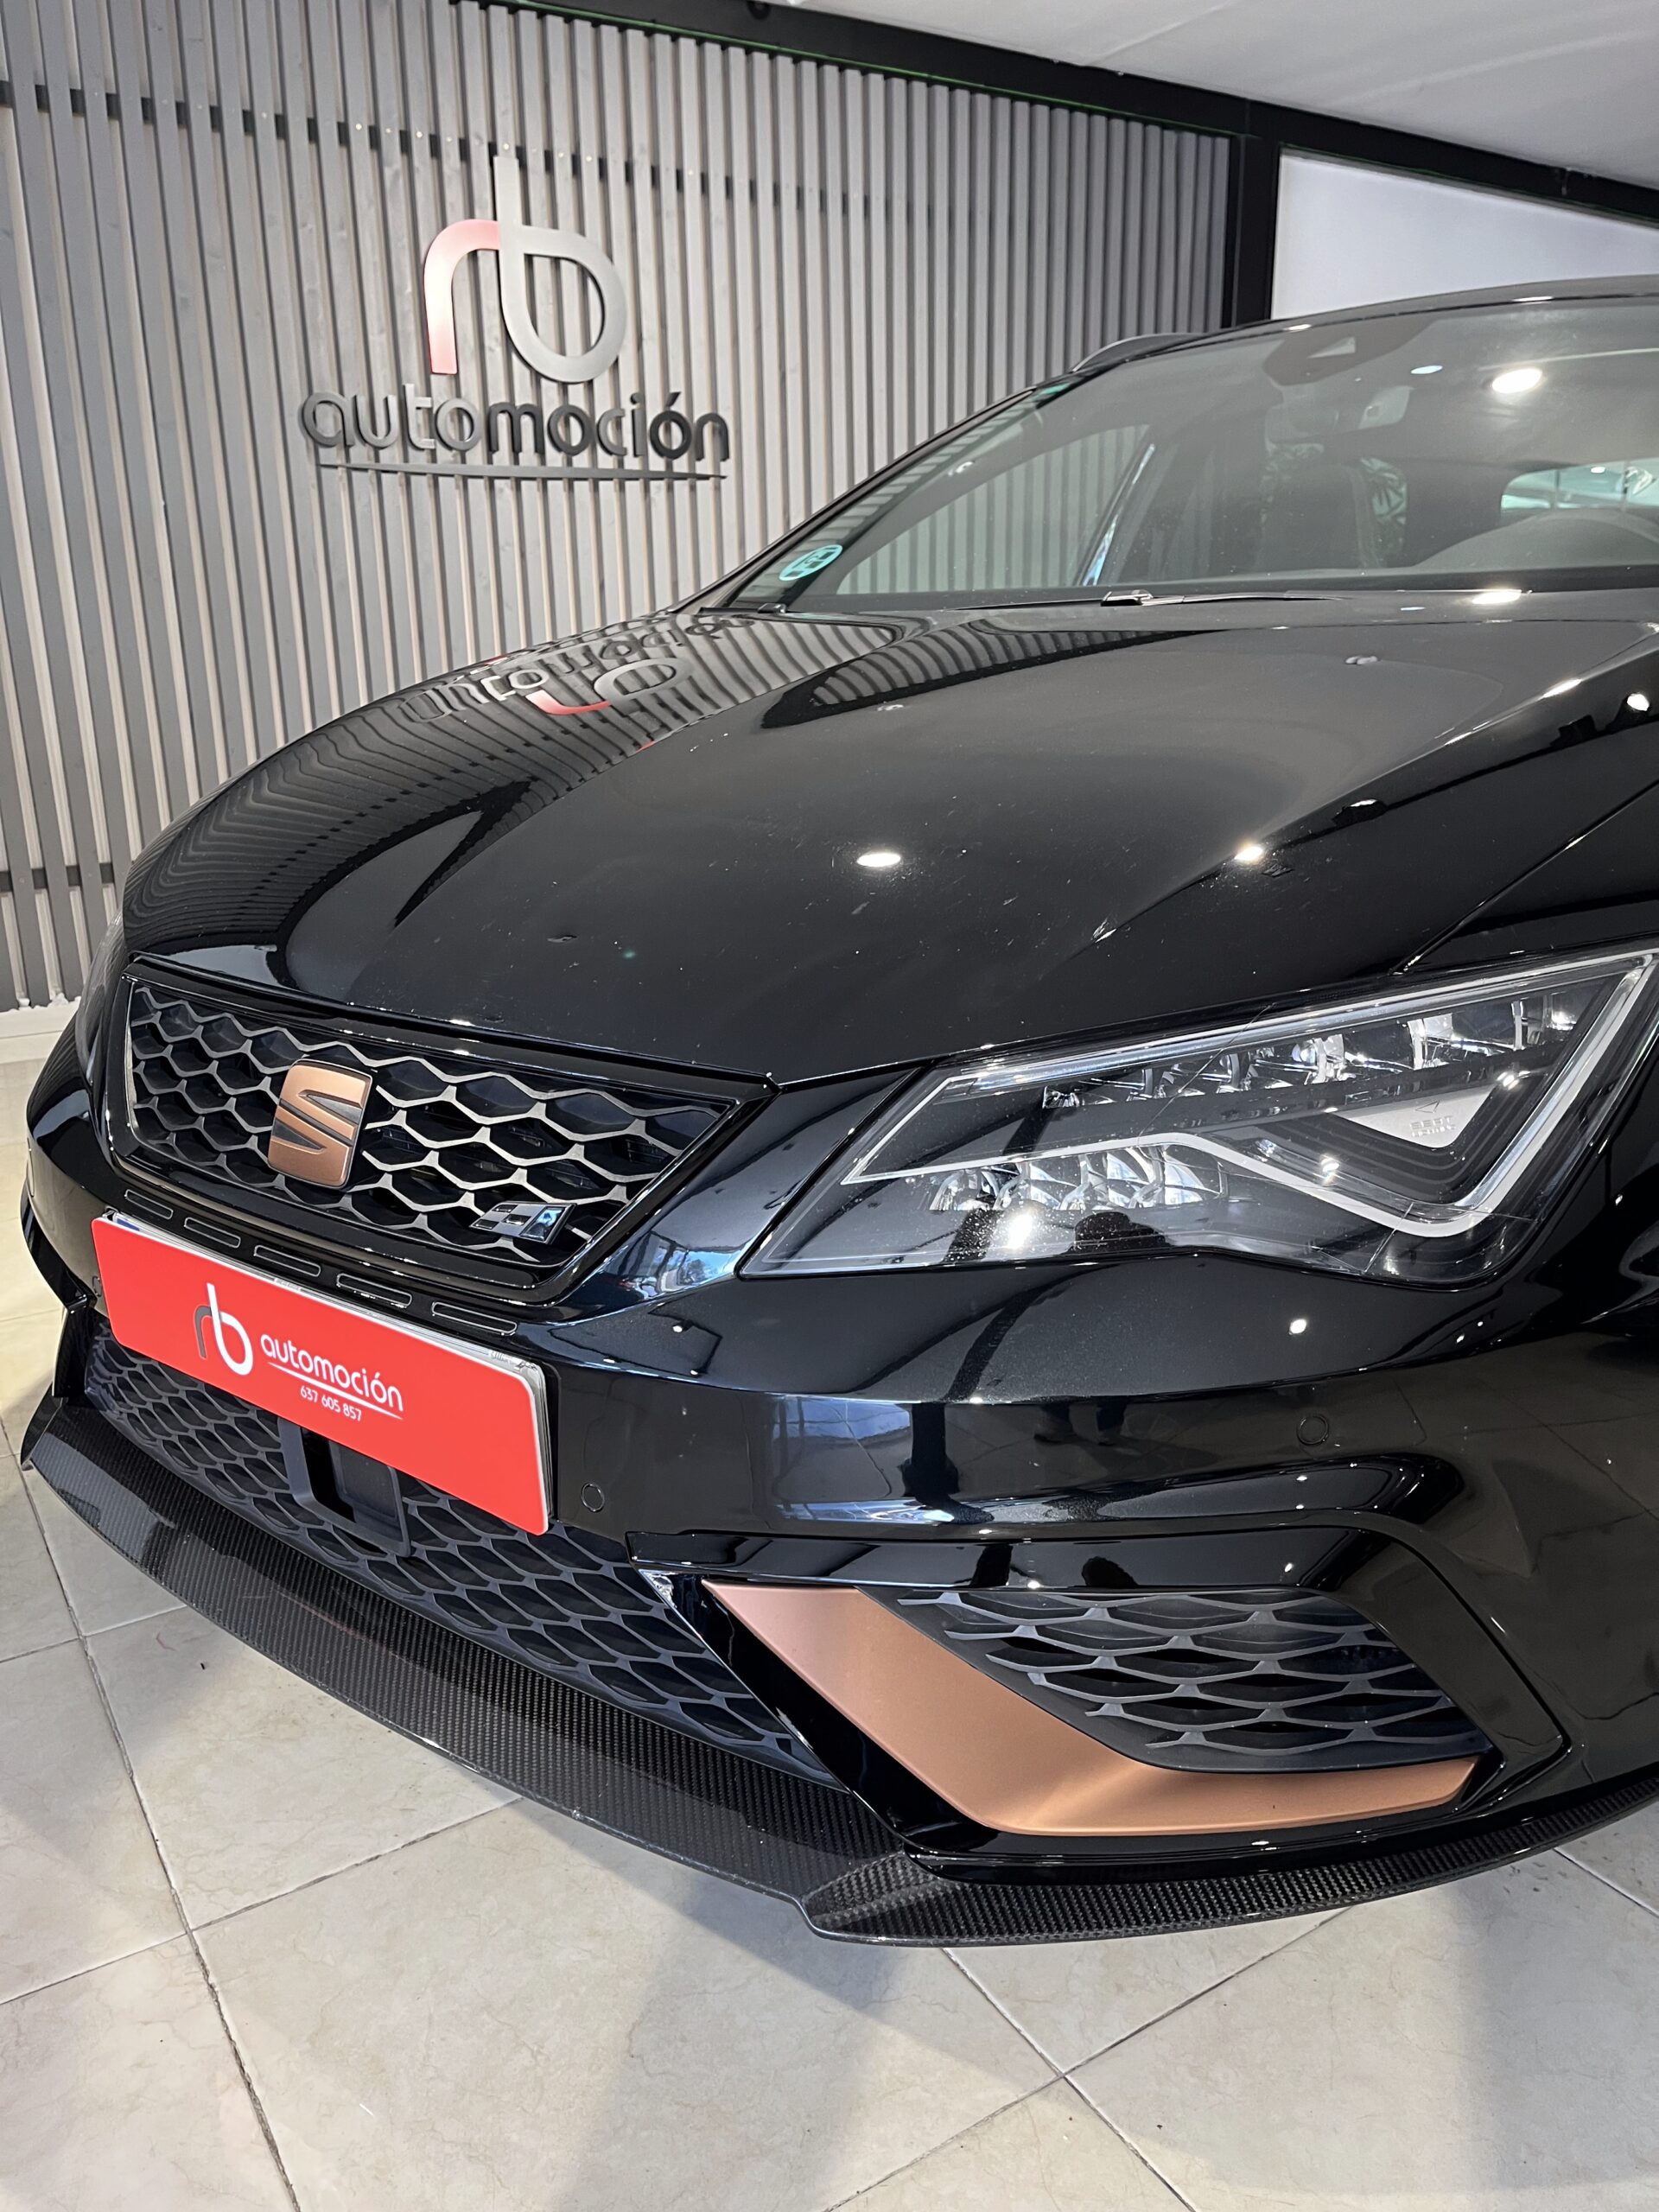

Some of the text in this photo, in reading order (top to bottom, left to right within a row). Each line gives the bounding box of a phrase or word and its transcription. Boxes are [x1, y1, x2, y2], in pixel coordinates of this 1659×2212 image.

[302, 383, 729, 461] automoción
[260, 1334, 404, 1412] automoción
[300, 1385, 362, 1421] 637 605 857
